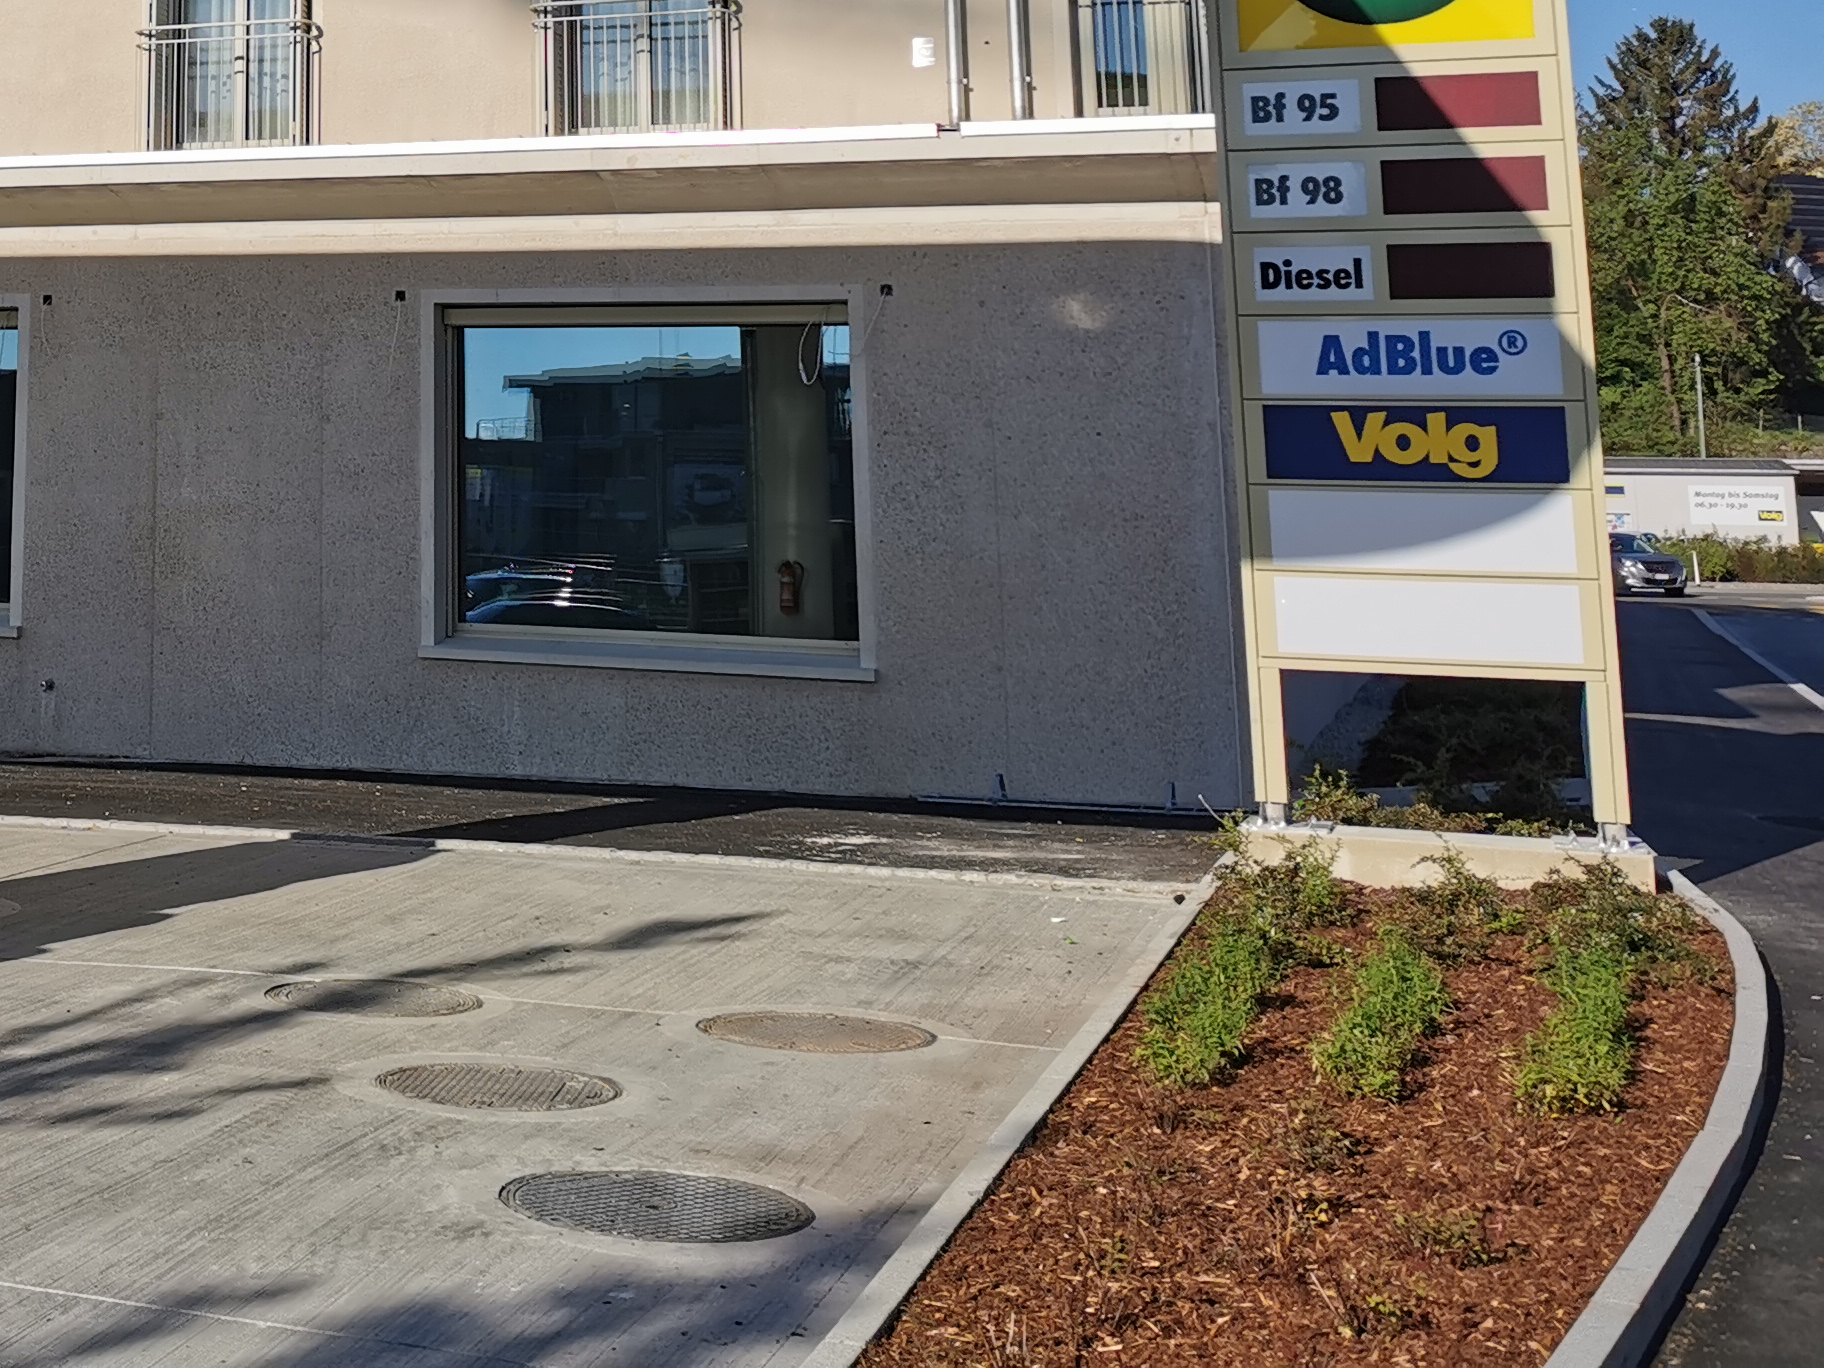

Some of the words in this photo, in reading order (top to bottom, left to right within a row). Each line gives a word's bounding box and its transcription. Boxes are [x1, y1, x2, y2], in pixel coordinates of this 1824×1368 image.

[1250, 91, 1287, 124] Bf
[1296, 92, 1341, 122] 95
[1253, 174, 1291, 207] Bf
[1300, 175, 1344, 206] 98
[1259, 257, 1365, 291] Diesel
[1329, 410, 1499, 479] Volg
[1728, 491, 1741, 499] bis
